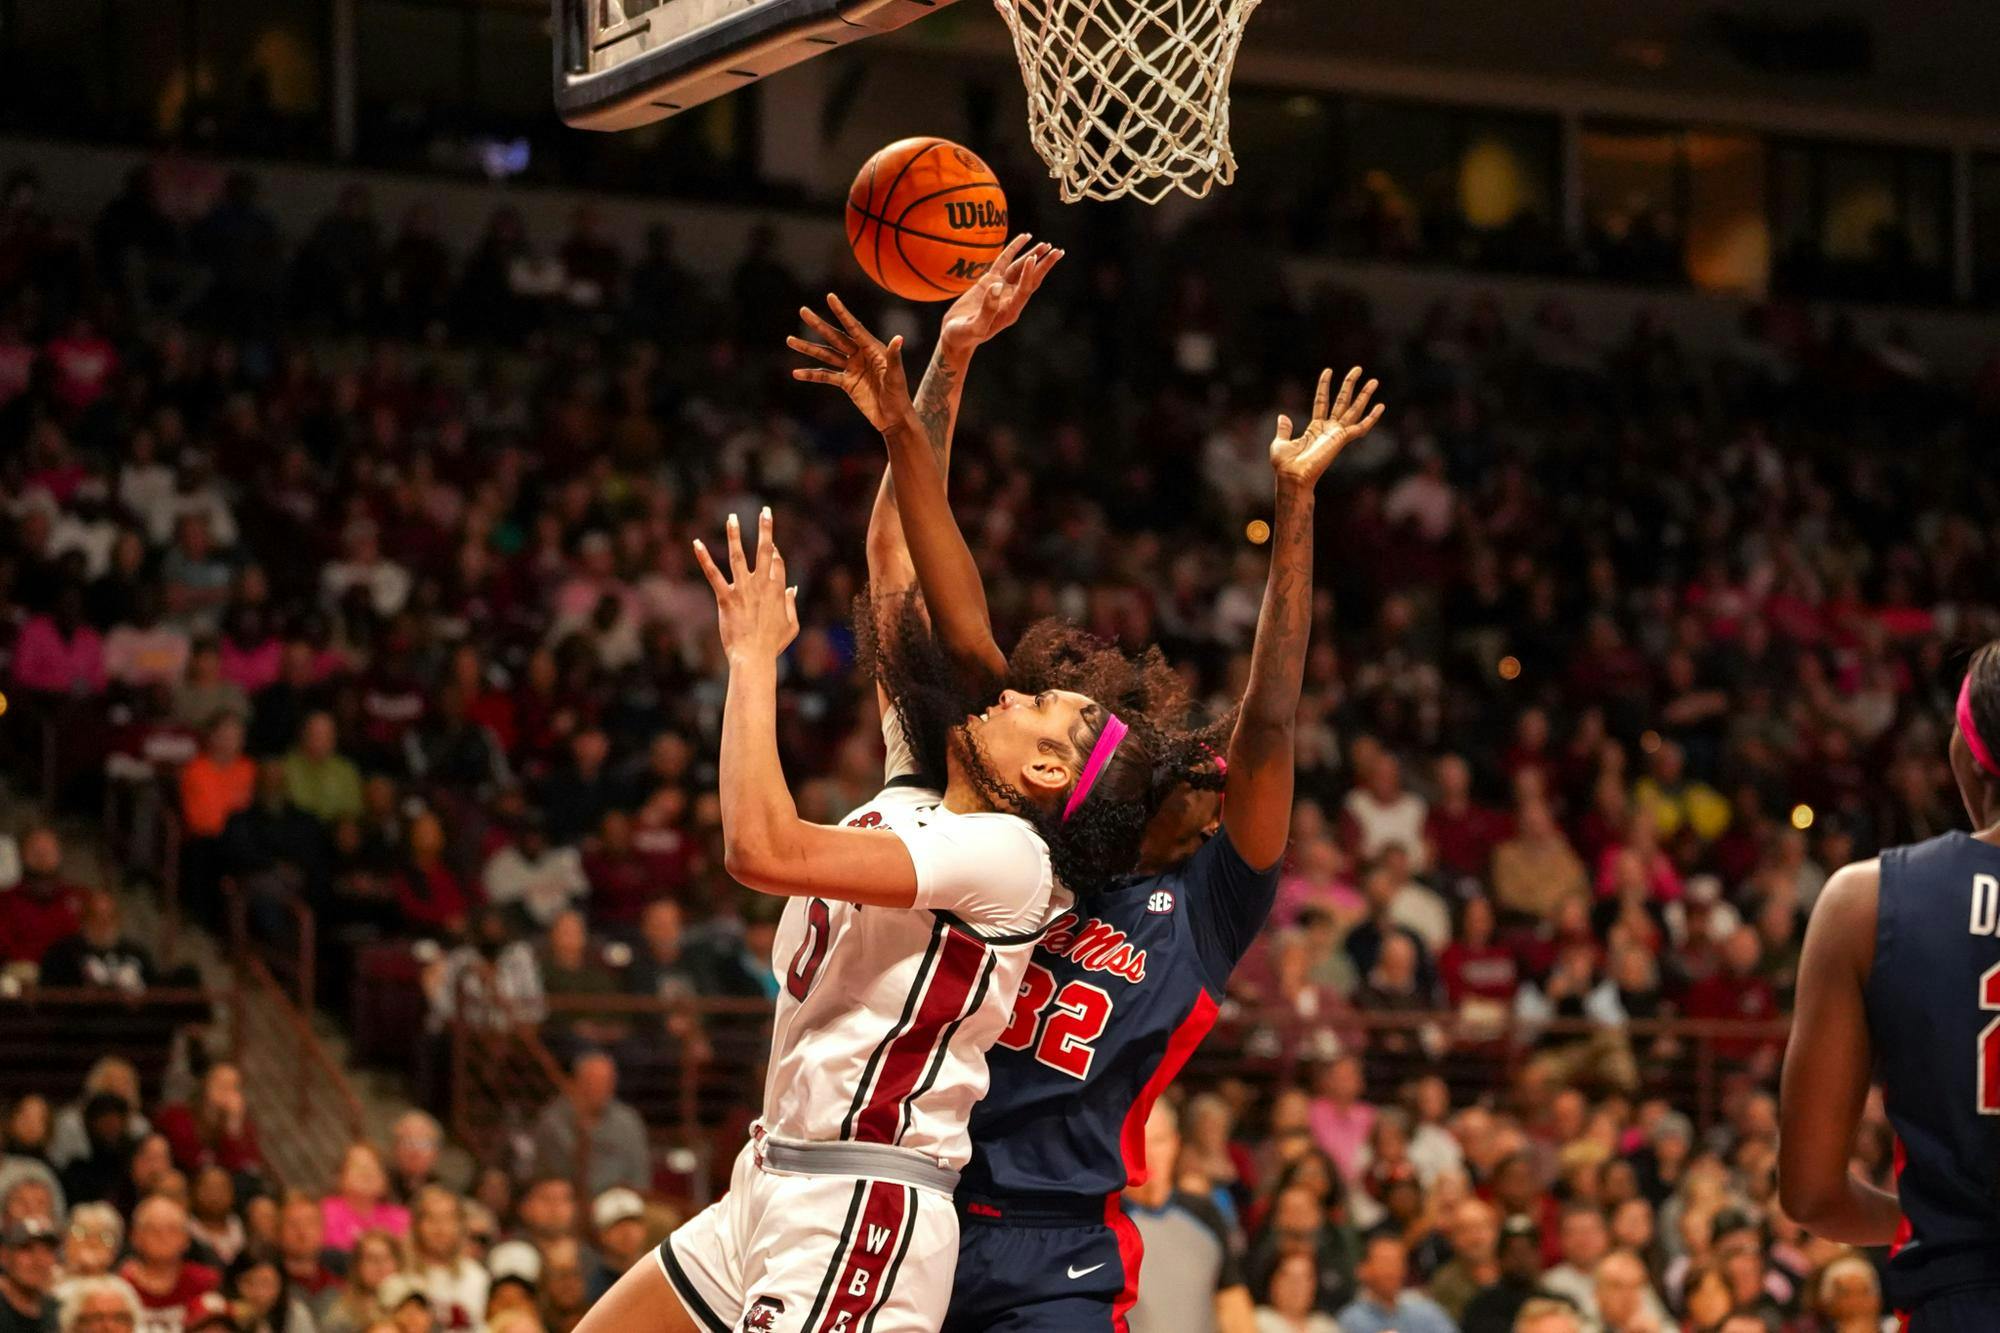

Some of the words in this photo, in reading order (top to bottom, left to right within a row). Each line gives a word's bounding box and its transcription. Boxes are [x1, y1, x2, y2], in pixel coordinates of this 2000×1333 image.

[944, 200, 1007, 230] Wilso
[1147, 891, 1173, 912] SEC
[1969, 872, 2000, 938] D
[1060, 917, 1147, 984] Mss
[996, 961, 1114, 1081] 32
